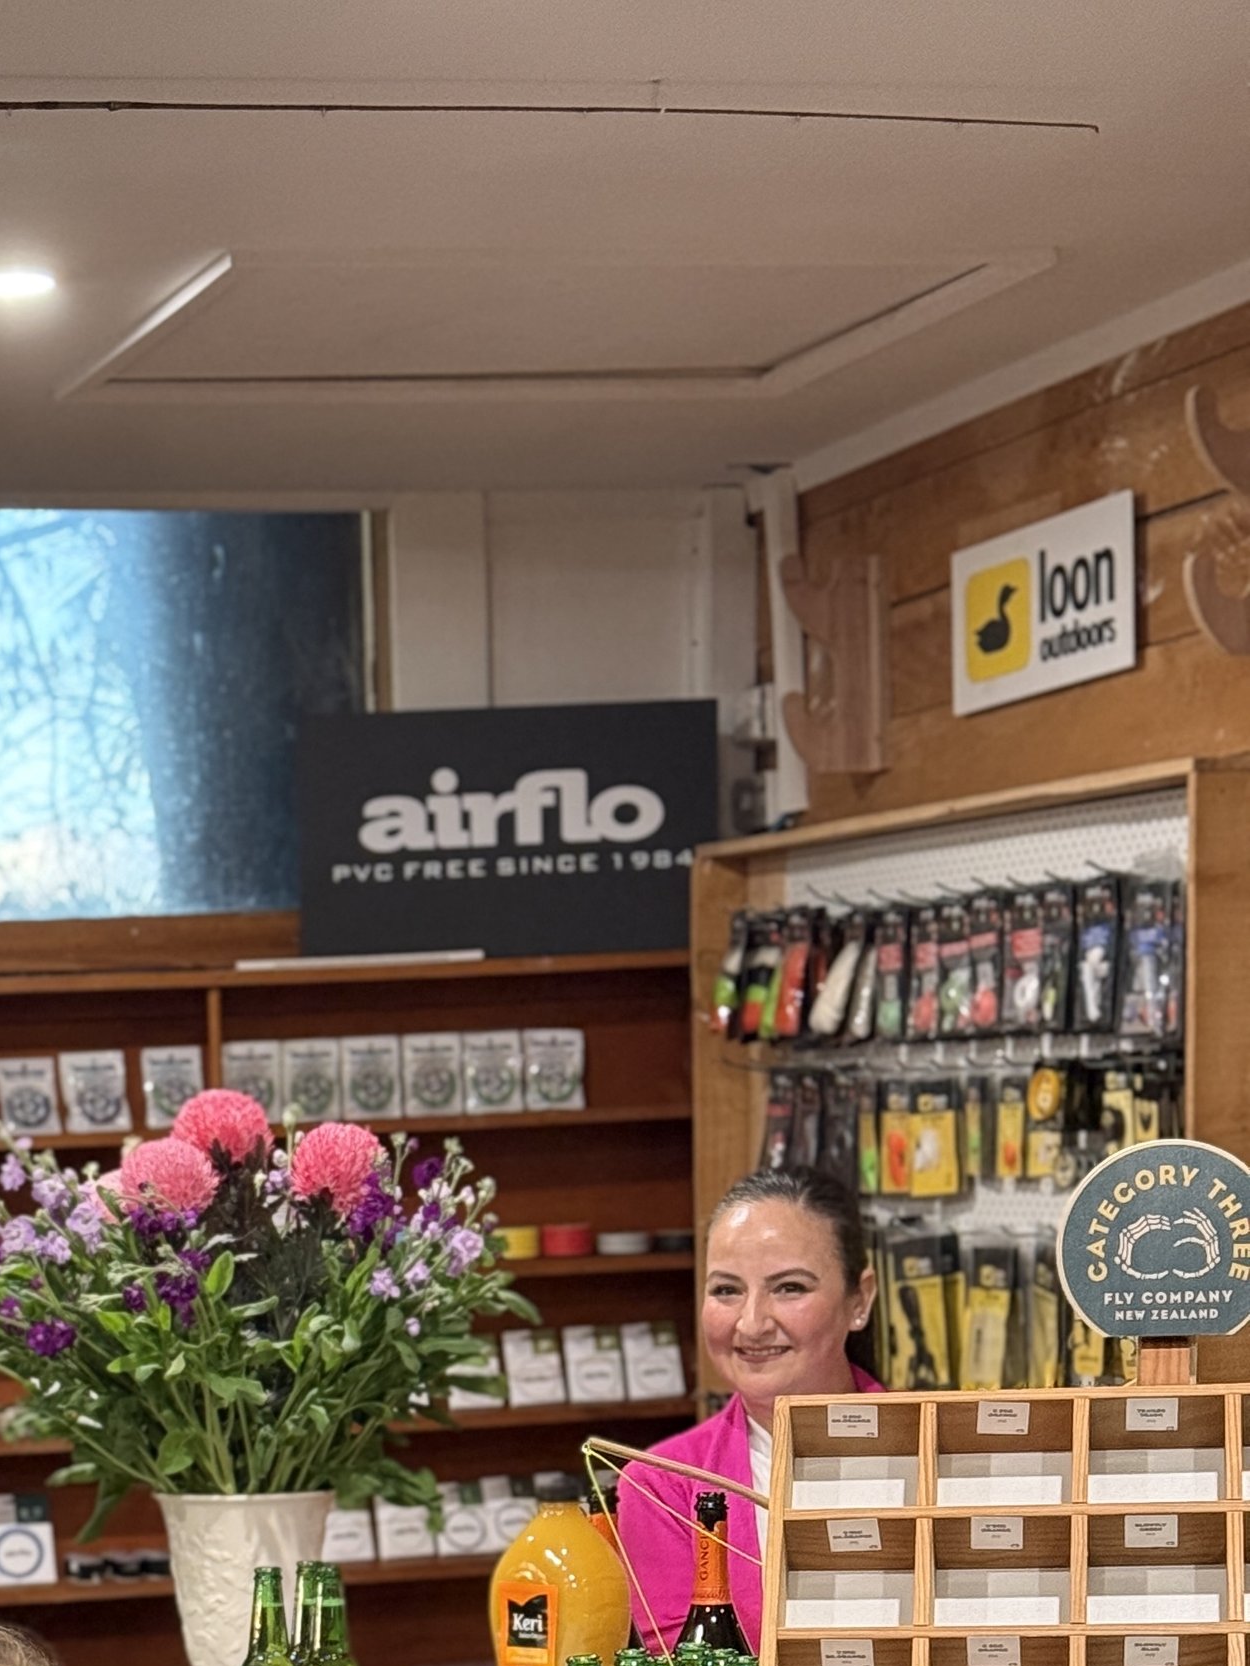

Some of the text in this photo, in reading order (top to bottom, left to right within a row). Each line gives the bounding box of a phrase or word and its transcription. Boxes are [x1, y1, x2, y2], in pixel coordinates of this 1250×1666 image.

[1038, 546, 1115, 624] loon
[1040, 616, 1116, 662] outdoors
[358, 767, 665, 854] airflo
[331, 848, 694, 884] PVC FREE SINCE 1984
[1085, 1164, 1250, 1283] CATEGORY THREE
[1103, 1290, 1234, 1305] FLY COMPANY
[1114, 1308, 1220, 1321] NEW ZEALAND
[699, 1526, 711, 1581] GANCI
[512, 1612, 543, 1633] Keri
